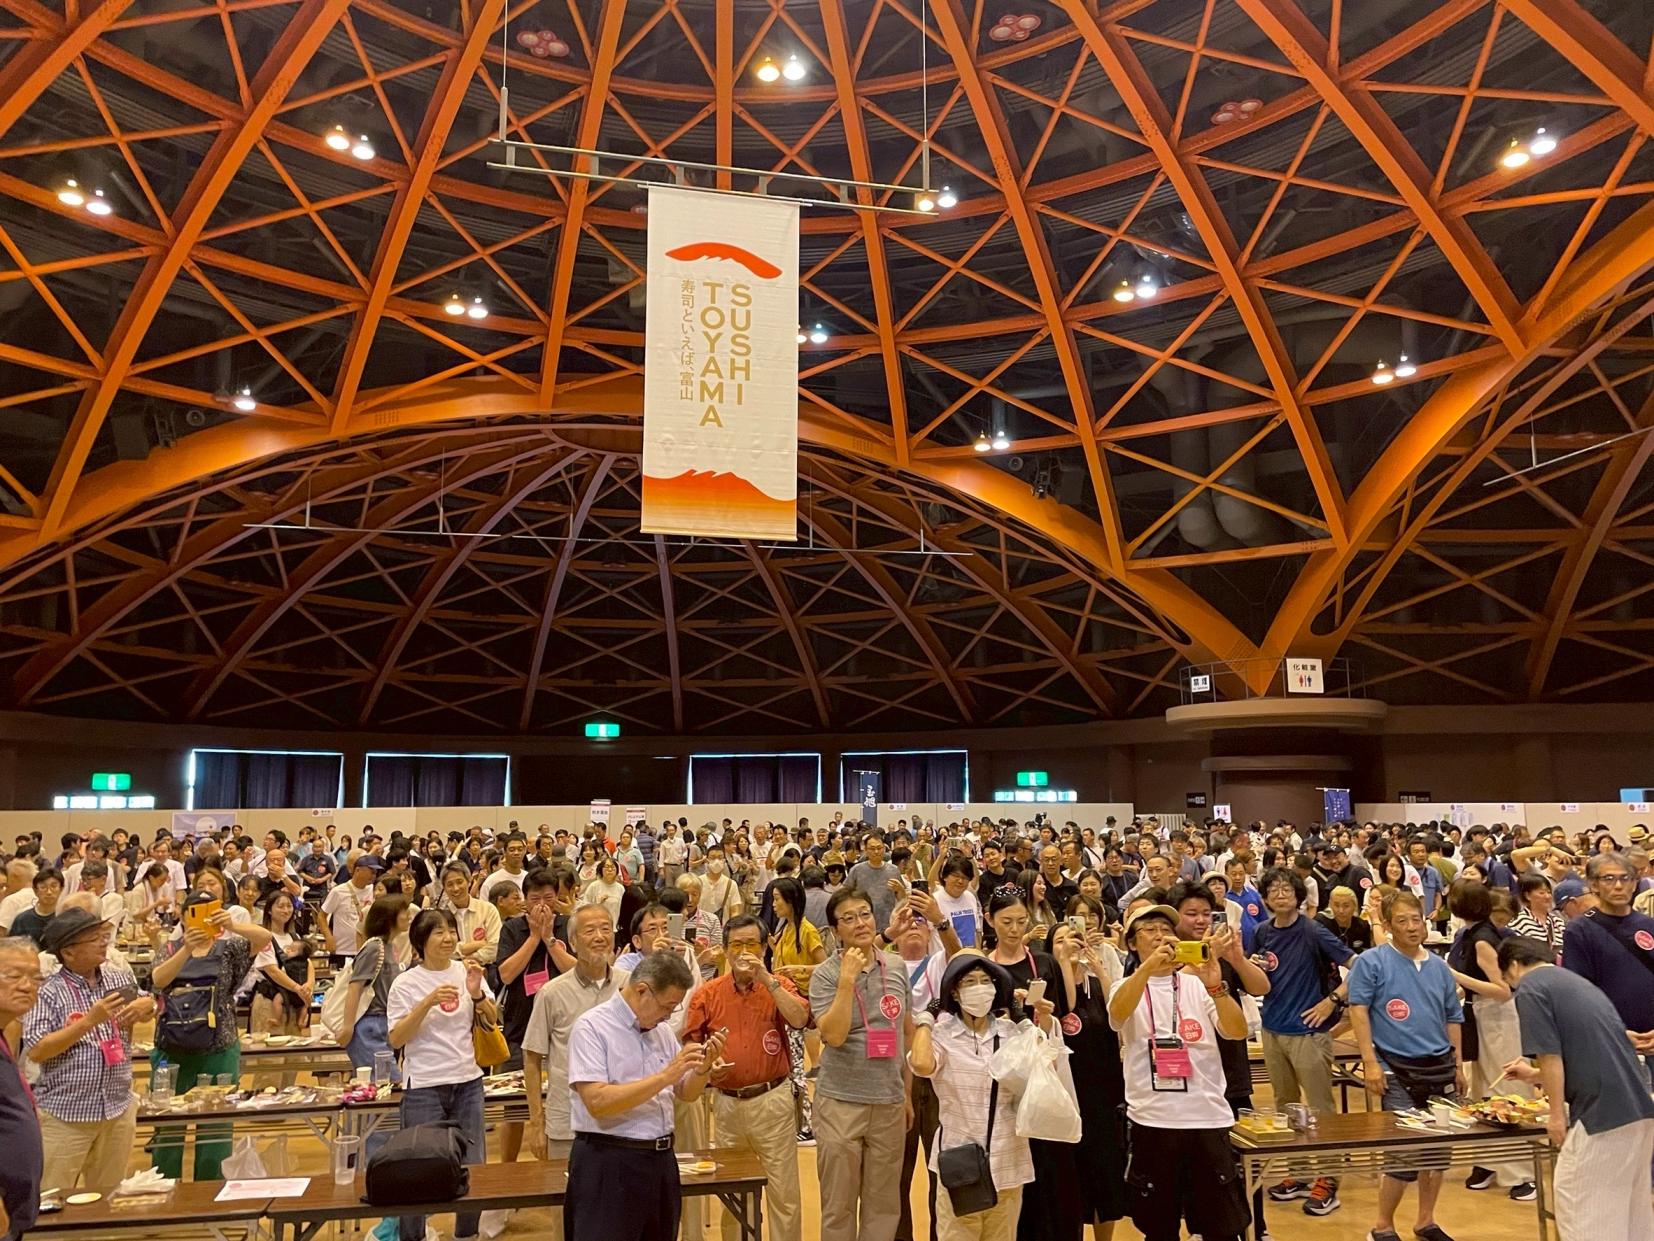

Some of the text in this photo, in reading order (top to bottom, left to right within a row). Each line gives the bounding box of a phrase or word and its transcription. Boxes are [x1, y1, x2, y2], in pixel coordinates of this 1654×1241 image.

[680, 279, 695, 401] 寿司といえば、富山
[699, 281, 725, 428] TOYAMA
[730, 283, 753, 406] SUSHI
